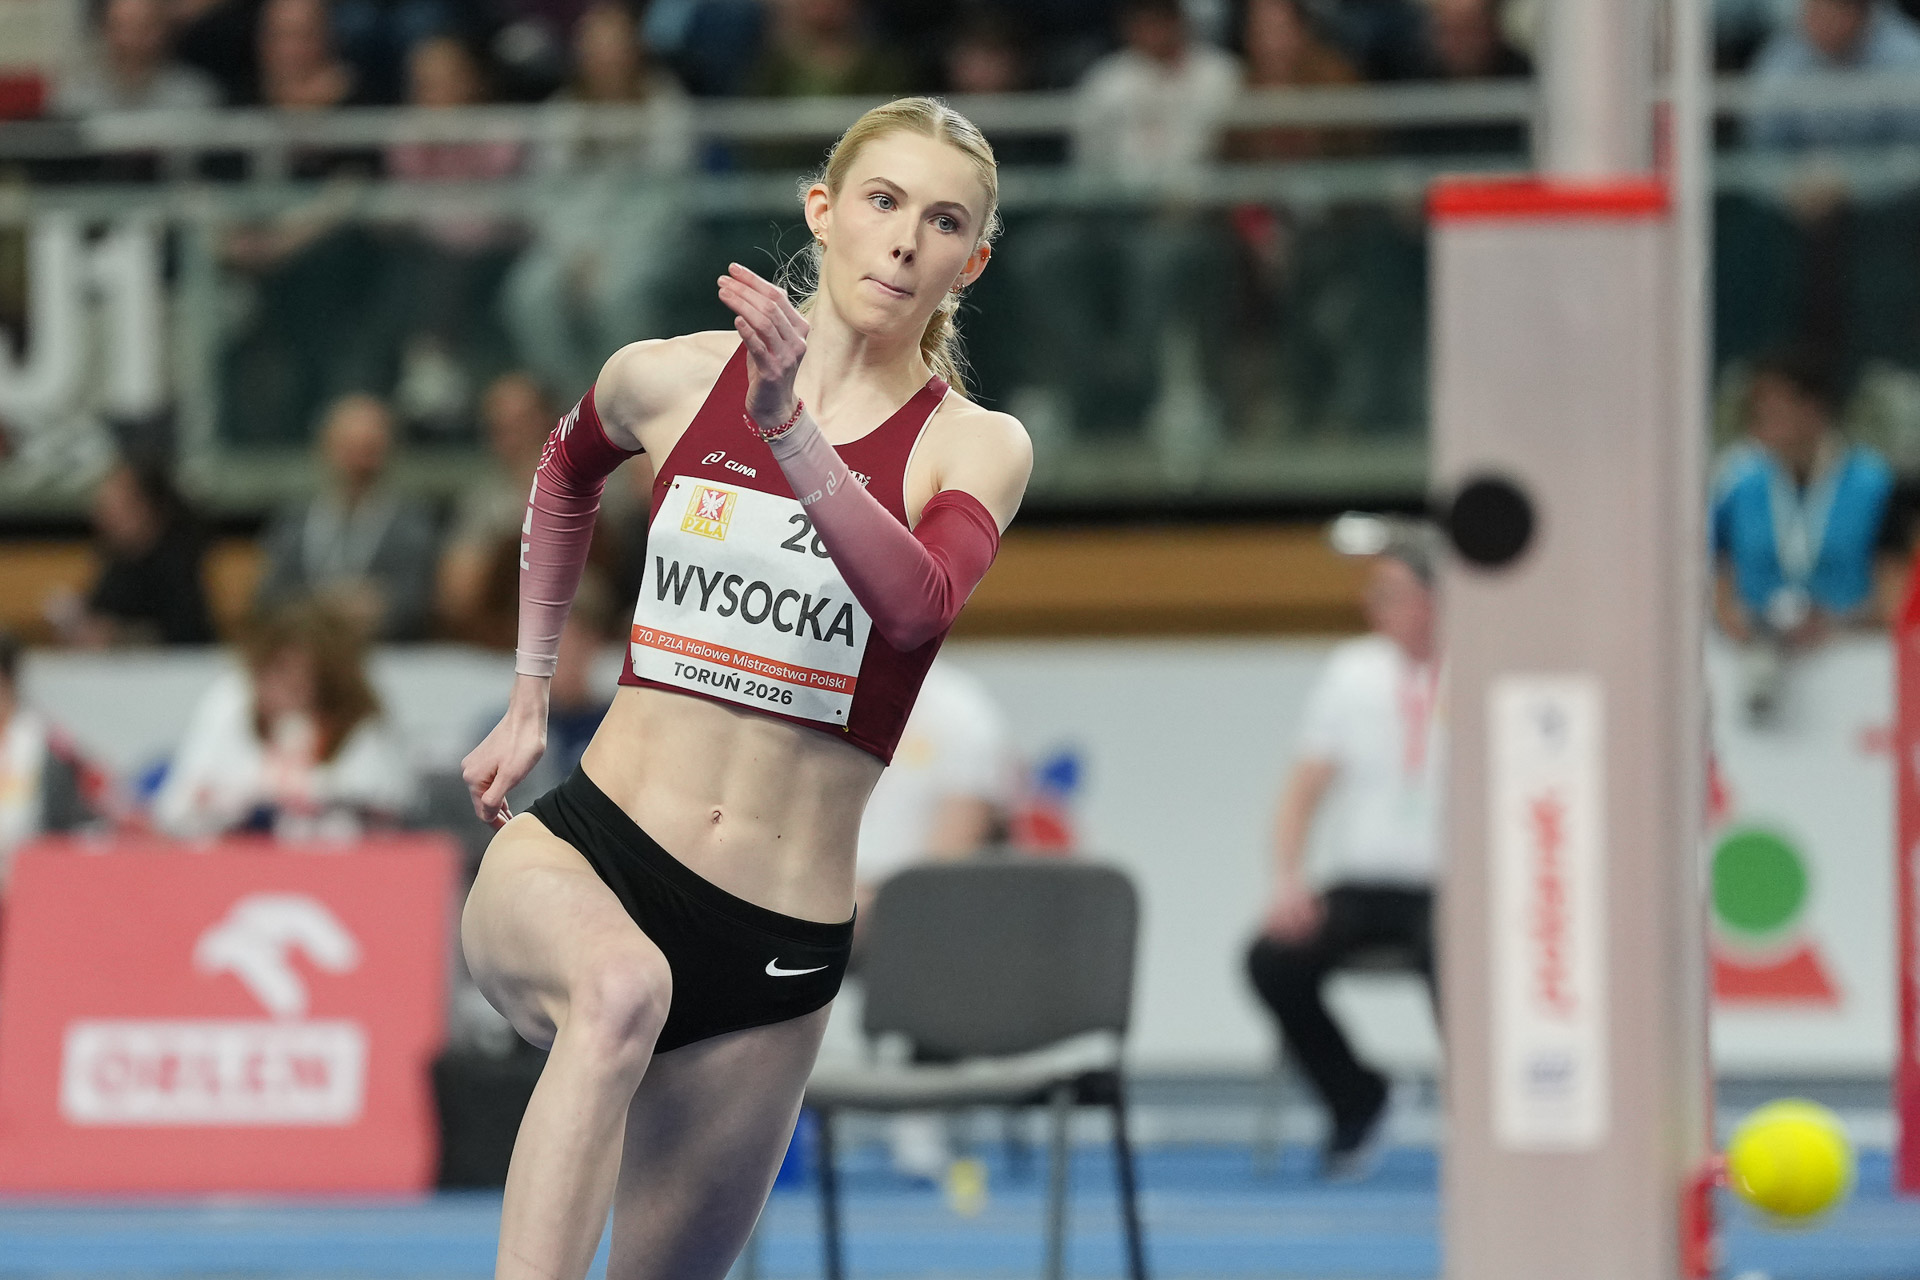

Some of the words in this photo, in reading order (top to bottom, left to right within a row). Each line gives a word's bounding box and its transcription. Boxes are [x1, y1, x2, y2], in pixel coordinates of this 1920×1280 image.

[724, 460, 757, 479] CUNA
[681, 515, 726, 541] PZLA
[655, 556, 855, 648] WYSOCKA
[638, 628, 655, 644] 70.
[657, 634, 683, 652] PZLA
[686, 641, 731, 663] Halowe
[732, 653, 808, 683] Mistrzostwa
[809, 673, 847, 690] Polski
[674, 661, 742, 692] TORUŃ
[743, 680, 794, 706] 2026
